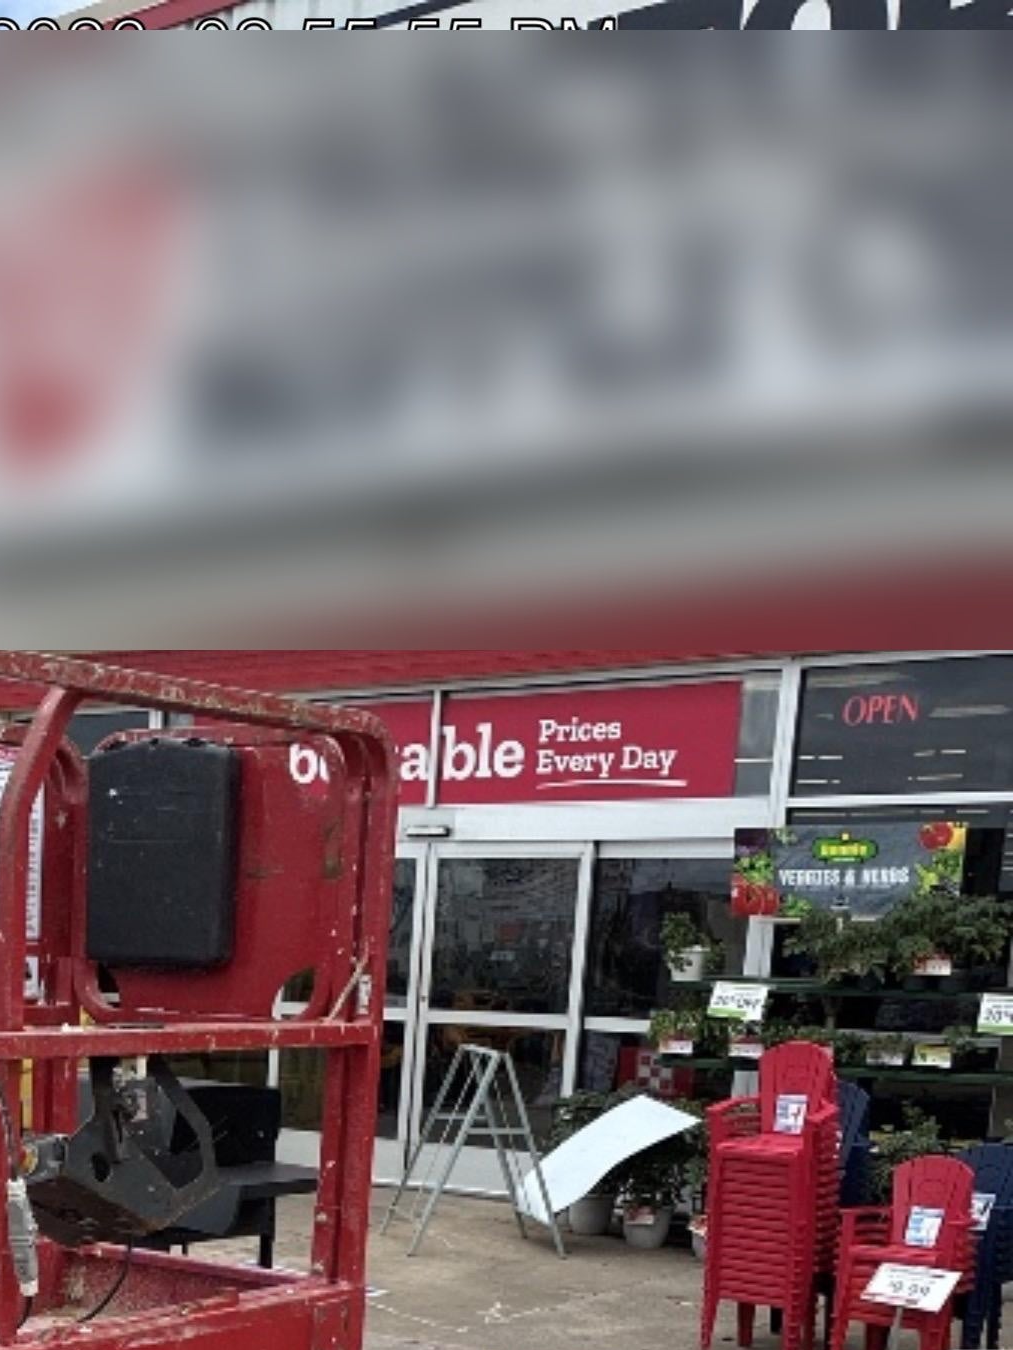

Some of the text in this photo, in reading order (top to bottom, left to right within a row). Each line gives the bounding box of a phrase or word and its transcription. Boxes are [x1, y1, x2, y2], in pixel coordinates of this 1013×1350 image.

[843, 693, 920, 726] OPEN
[539, 716, 622, 744] Prices
[536, 746, 678, 778] Every Day
